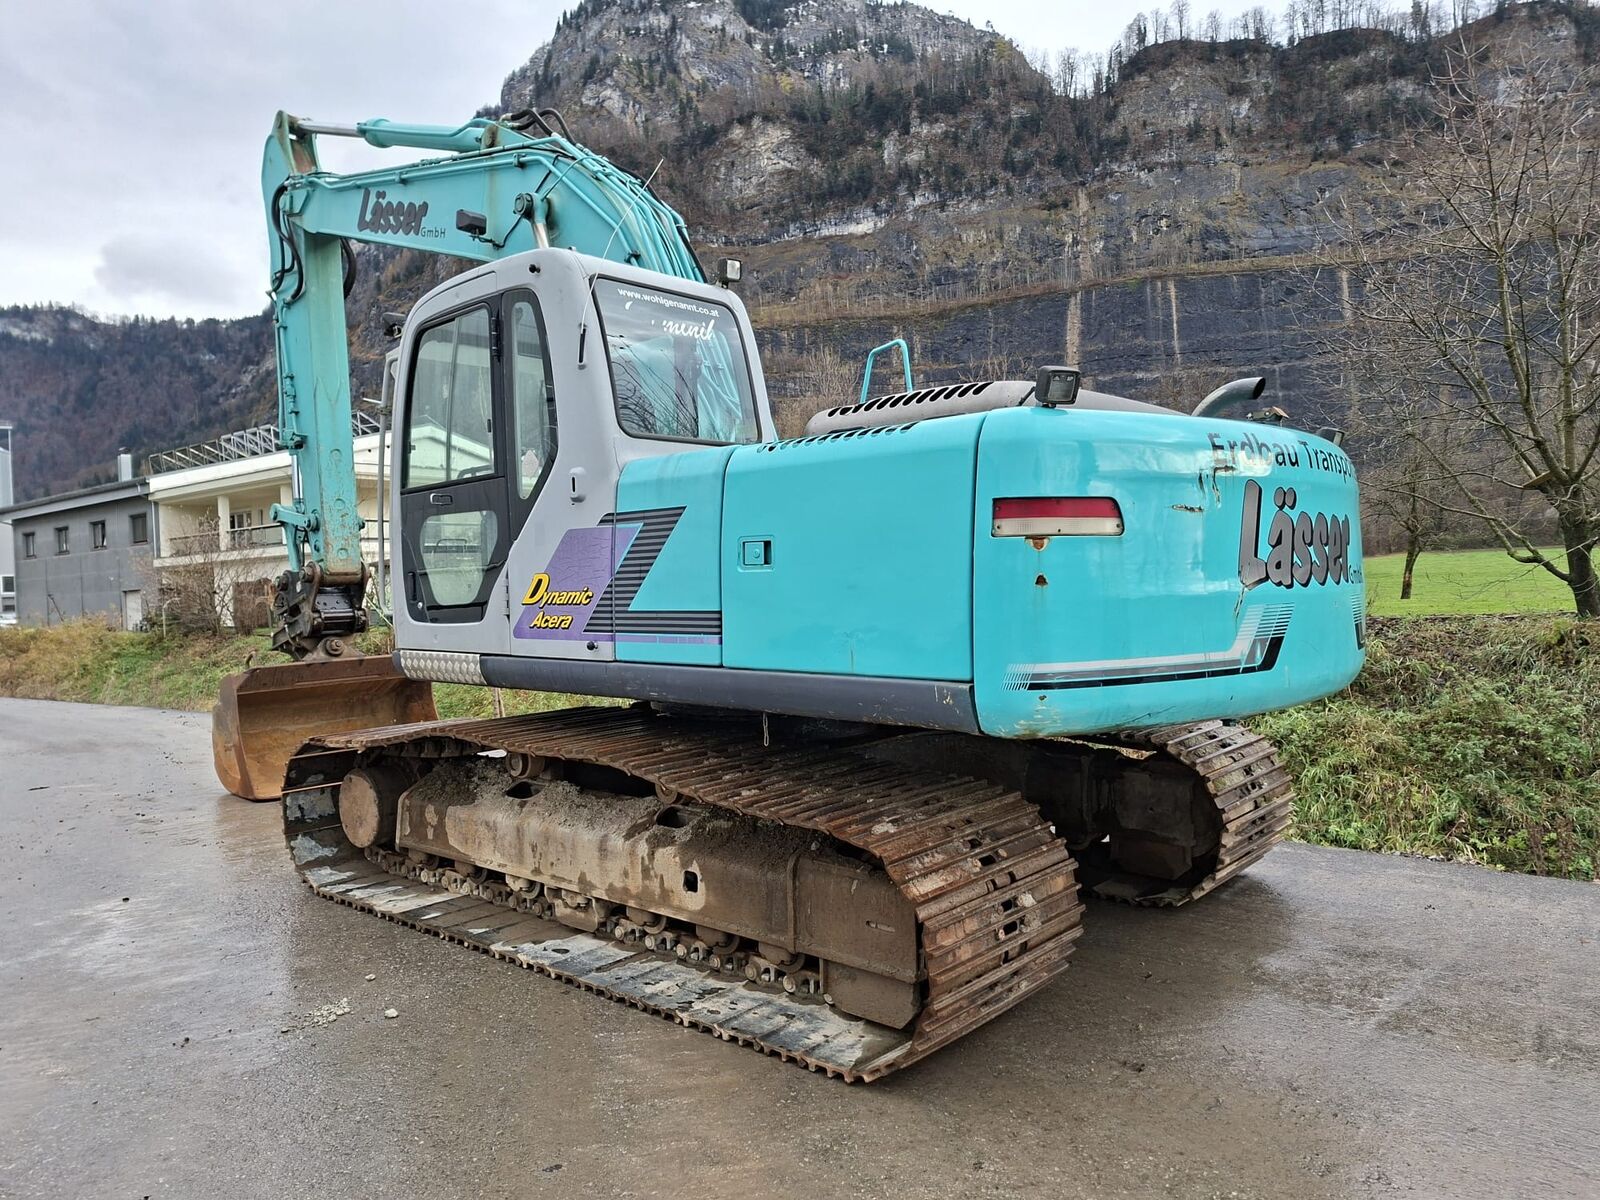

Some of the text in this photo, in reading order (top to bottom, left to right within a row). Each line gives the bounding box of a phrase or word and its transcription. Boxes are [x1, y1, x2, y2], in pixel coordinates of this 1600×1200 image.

[357, 187, 446, 239] Lässer GmbH
[617, 288, 720, 317] www.wohlgenannt.co.at
[1207, 431, 1300, 468] Erdbau
[1238, 478, 1349, 590] Lässer
[522, 572, 594, 609] Dynamic
[529, 610, 574, 630] Acera
